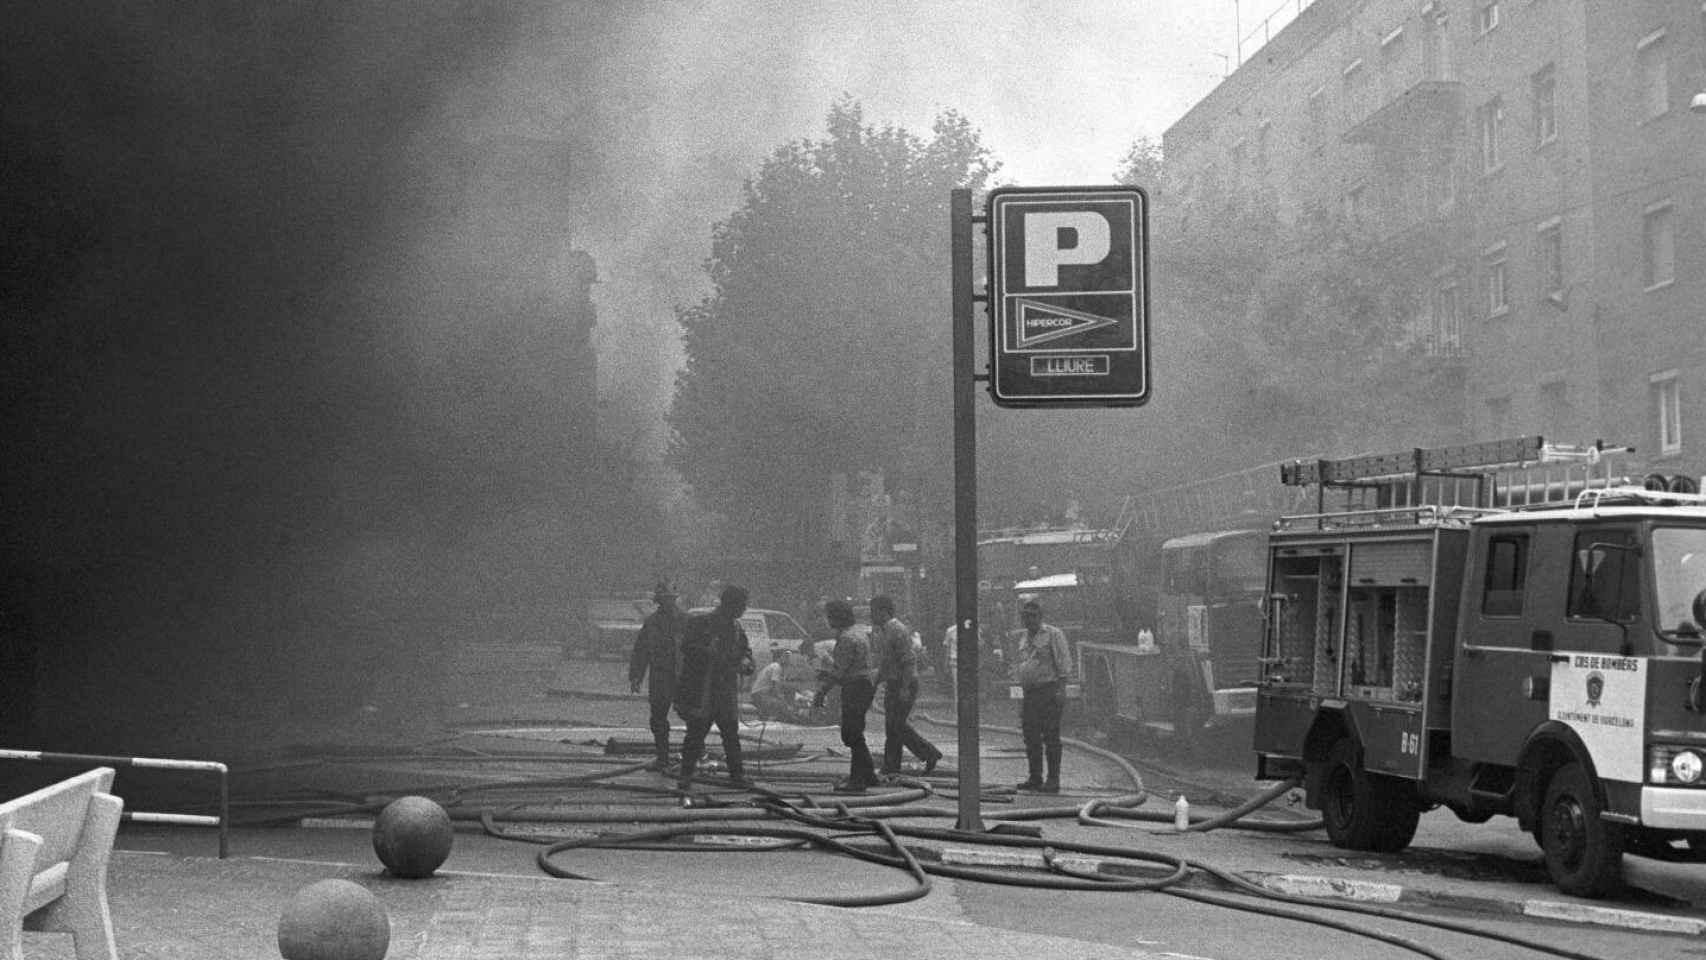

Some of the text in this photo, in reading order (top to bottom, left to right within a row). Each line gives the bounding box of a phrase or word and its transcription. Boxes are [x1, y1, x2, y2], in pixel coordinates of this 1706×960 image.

[1025, 211, 1111, 287] P
[1027, 318, 1072, 328] HIPERCOR
[1048, 359, 1096, 373] LLIURE
[1590, 656, 1600, 669] DE
